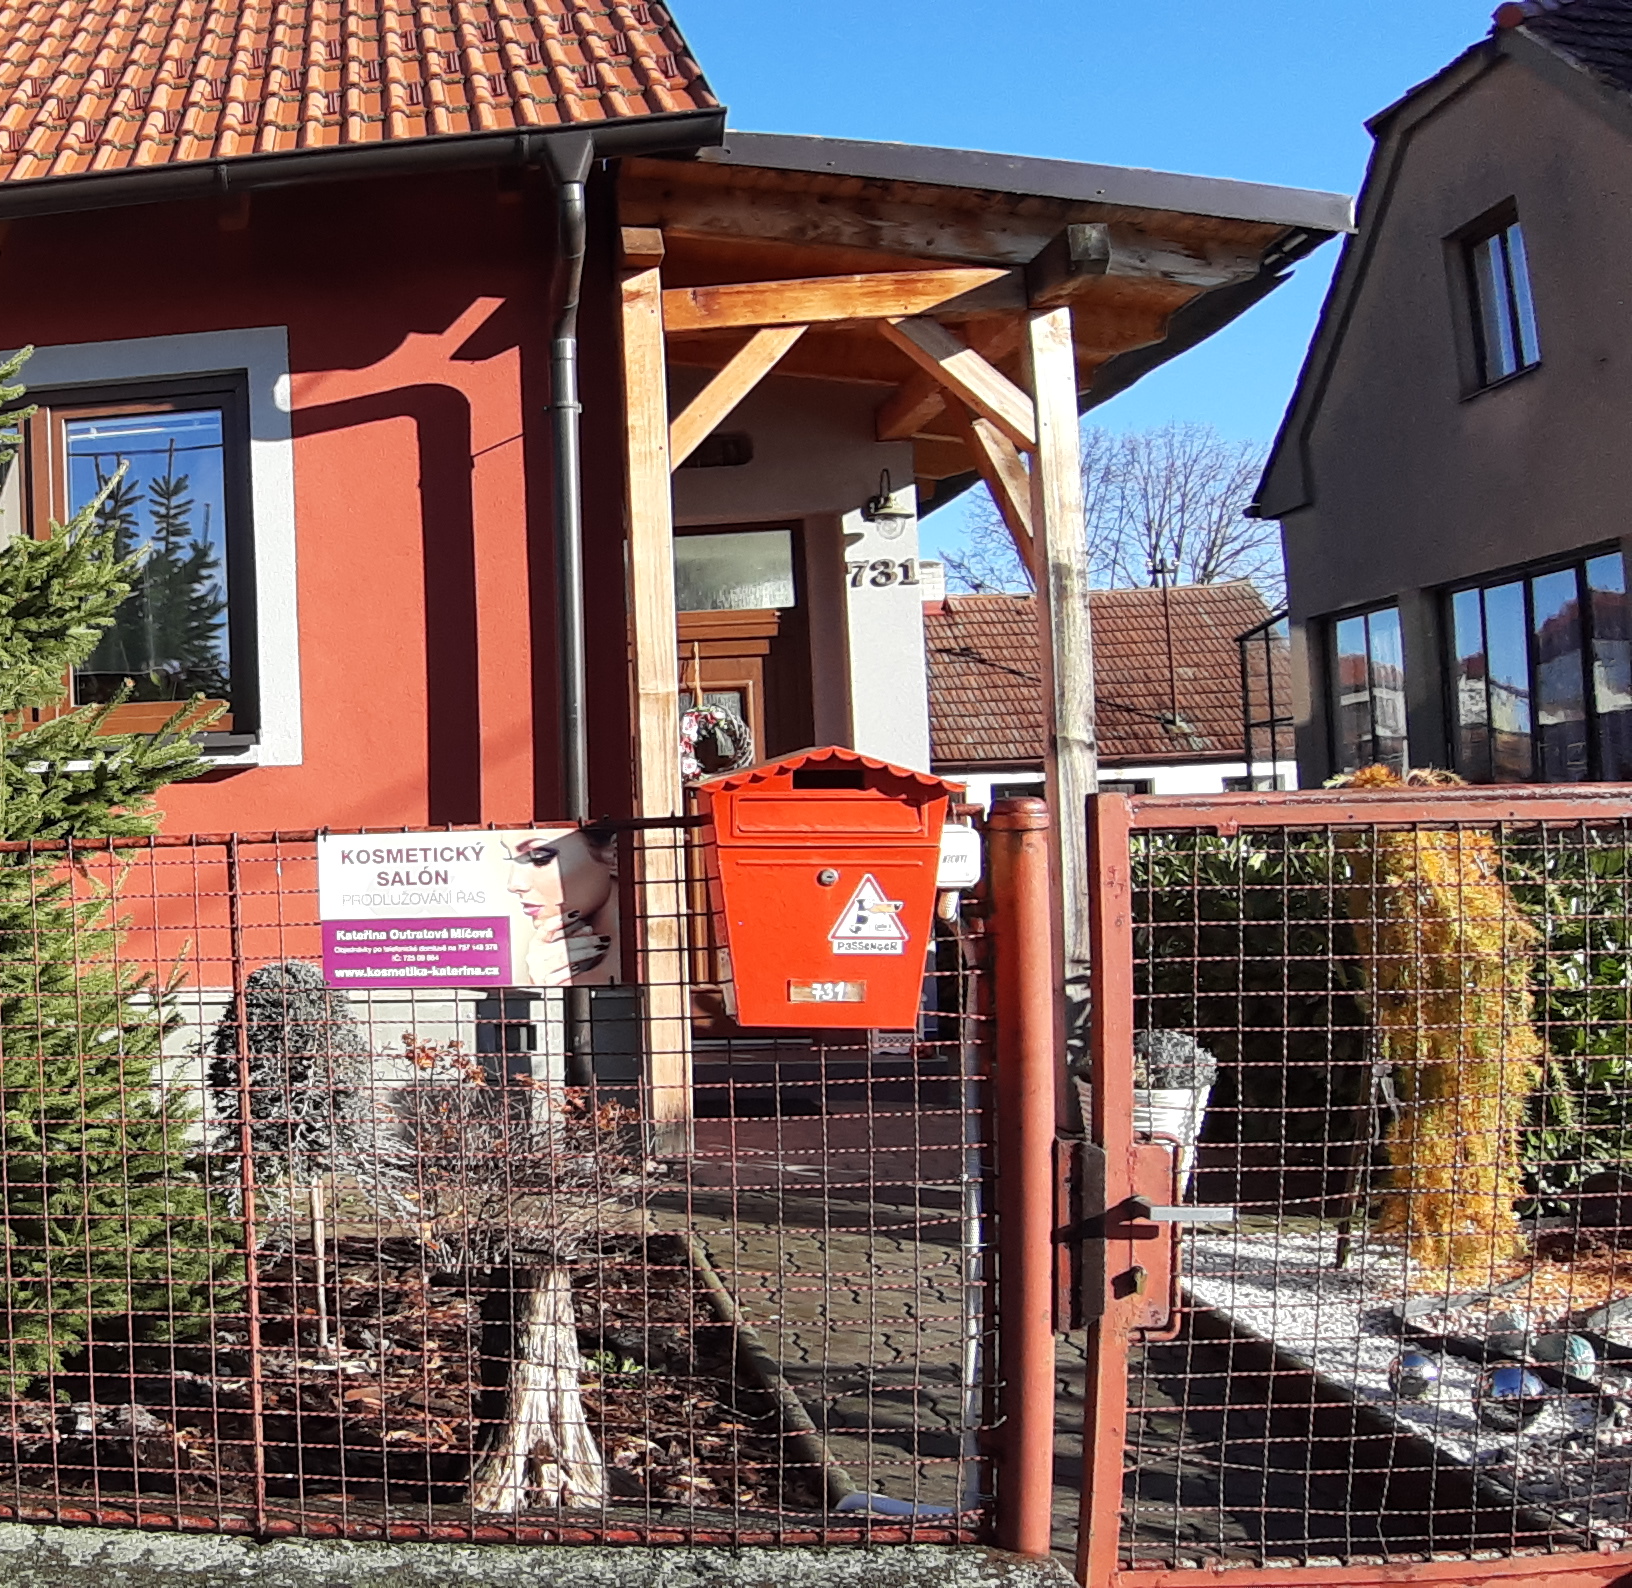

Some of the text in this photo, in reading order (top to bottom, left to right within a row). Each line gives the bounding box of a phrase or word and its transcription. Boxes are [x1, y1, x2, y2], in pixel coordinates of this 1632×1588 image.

[846, 557, 920, 588] 731
[340, 841, 486, 865] KOSMETICKÝ
[376, 865, 449, 887] SALÓN
[342, 889, 486, 907] PRODLUŽOVÁNÍ ŘAS
[336, 928, 387, 941] Kateřina
[334, 965, 500, 978] www.kosmetika-katerina.cz
[811, 981, 845, 1001] 731
